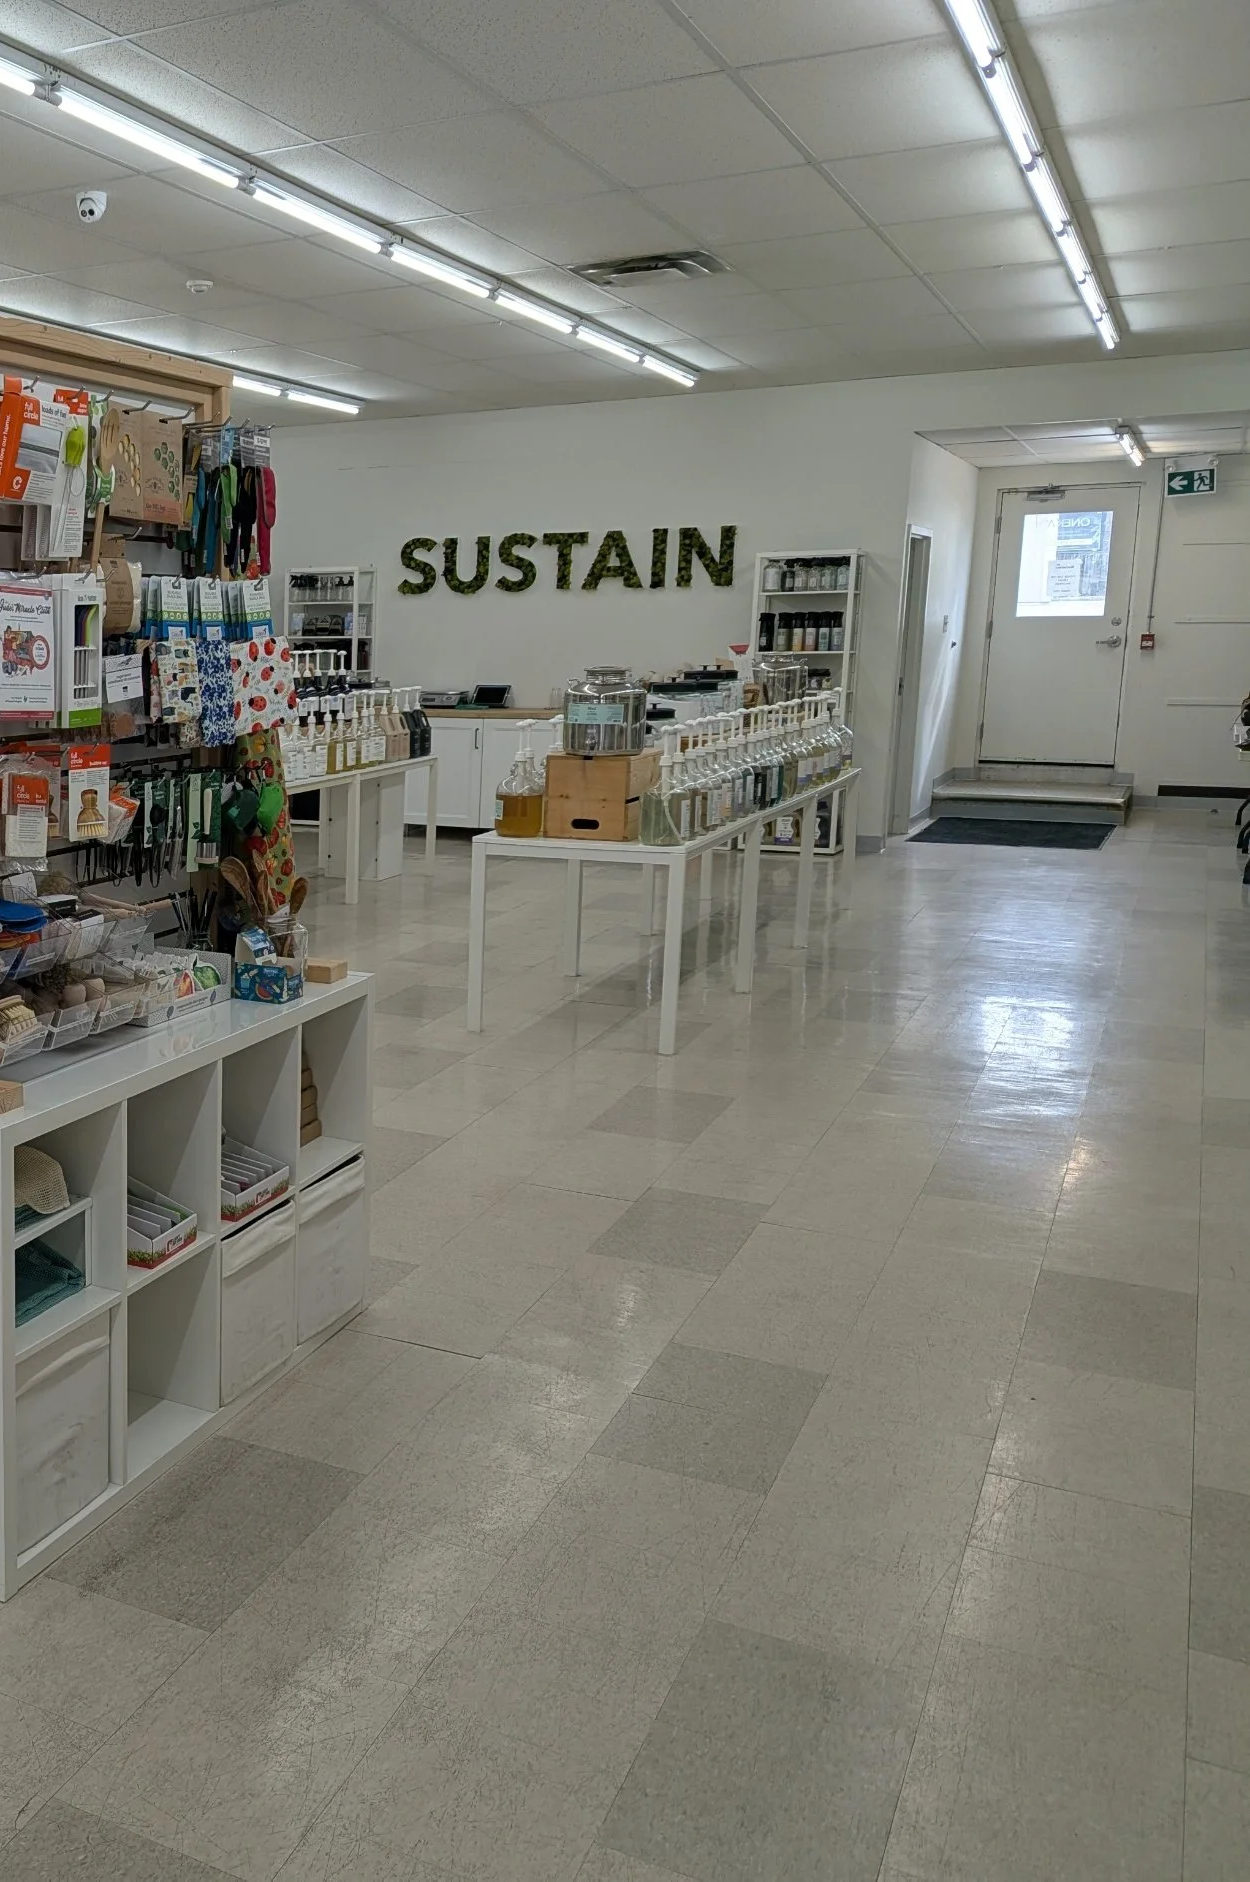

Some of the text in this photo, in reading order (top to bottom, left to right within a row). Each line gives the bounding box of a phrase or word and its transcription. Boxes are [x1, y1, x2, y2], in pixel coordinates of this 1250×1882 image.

[23, 411, 39, 421] circle
[41, 404, 53, 415] loads
[54, 407, 60, 416] of
[3, 414, 11, 434] home.
[397, 524, 737, 595] SUSTAIN
